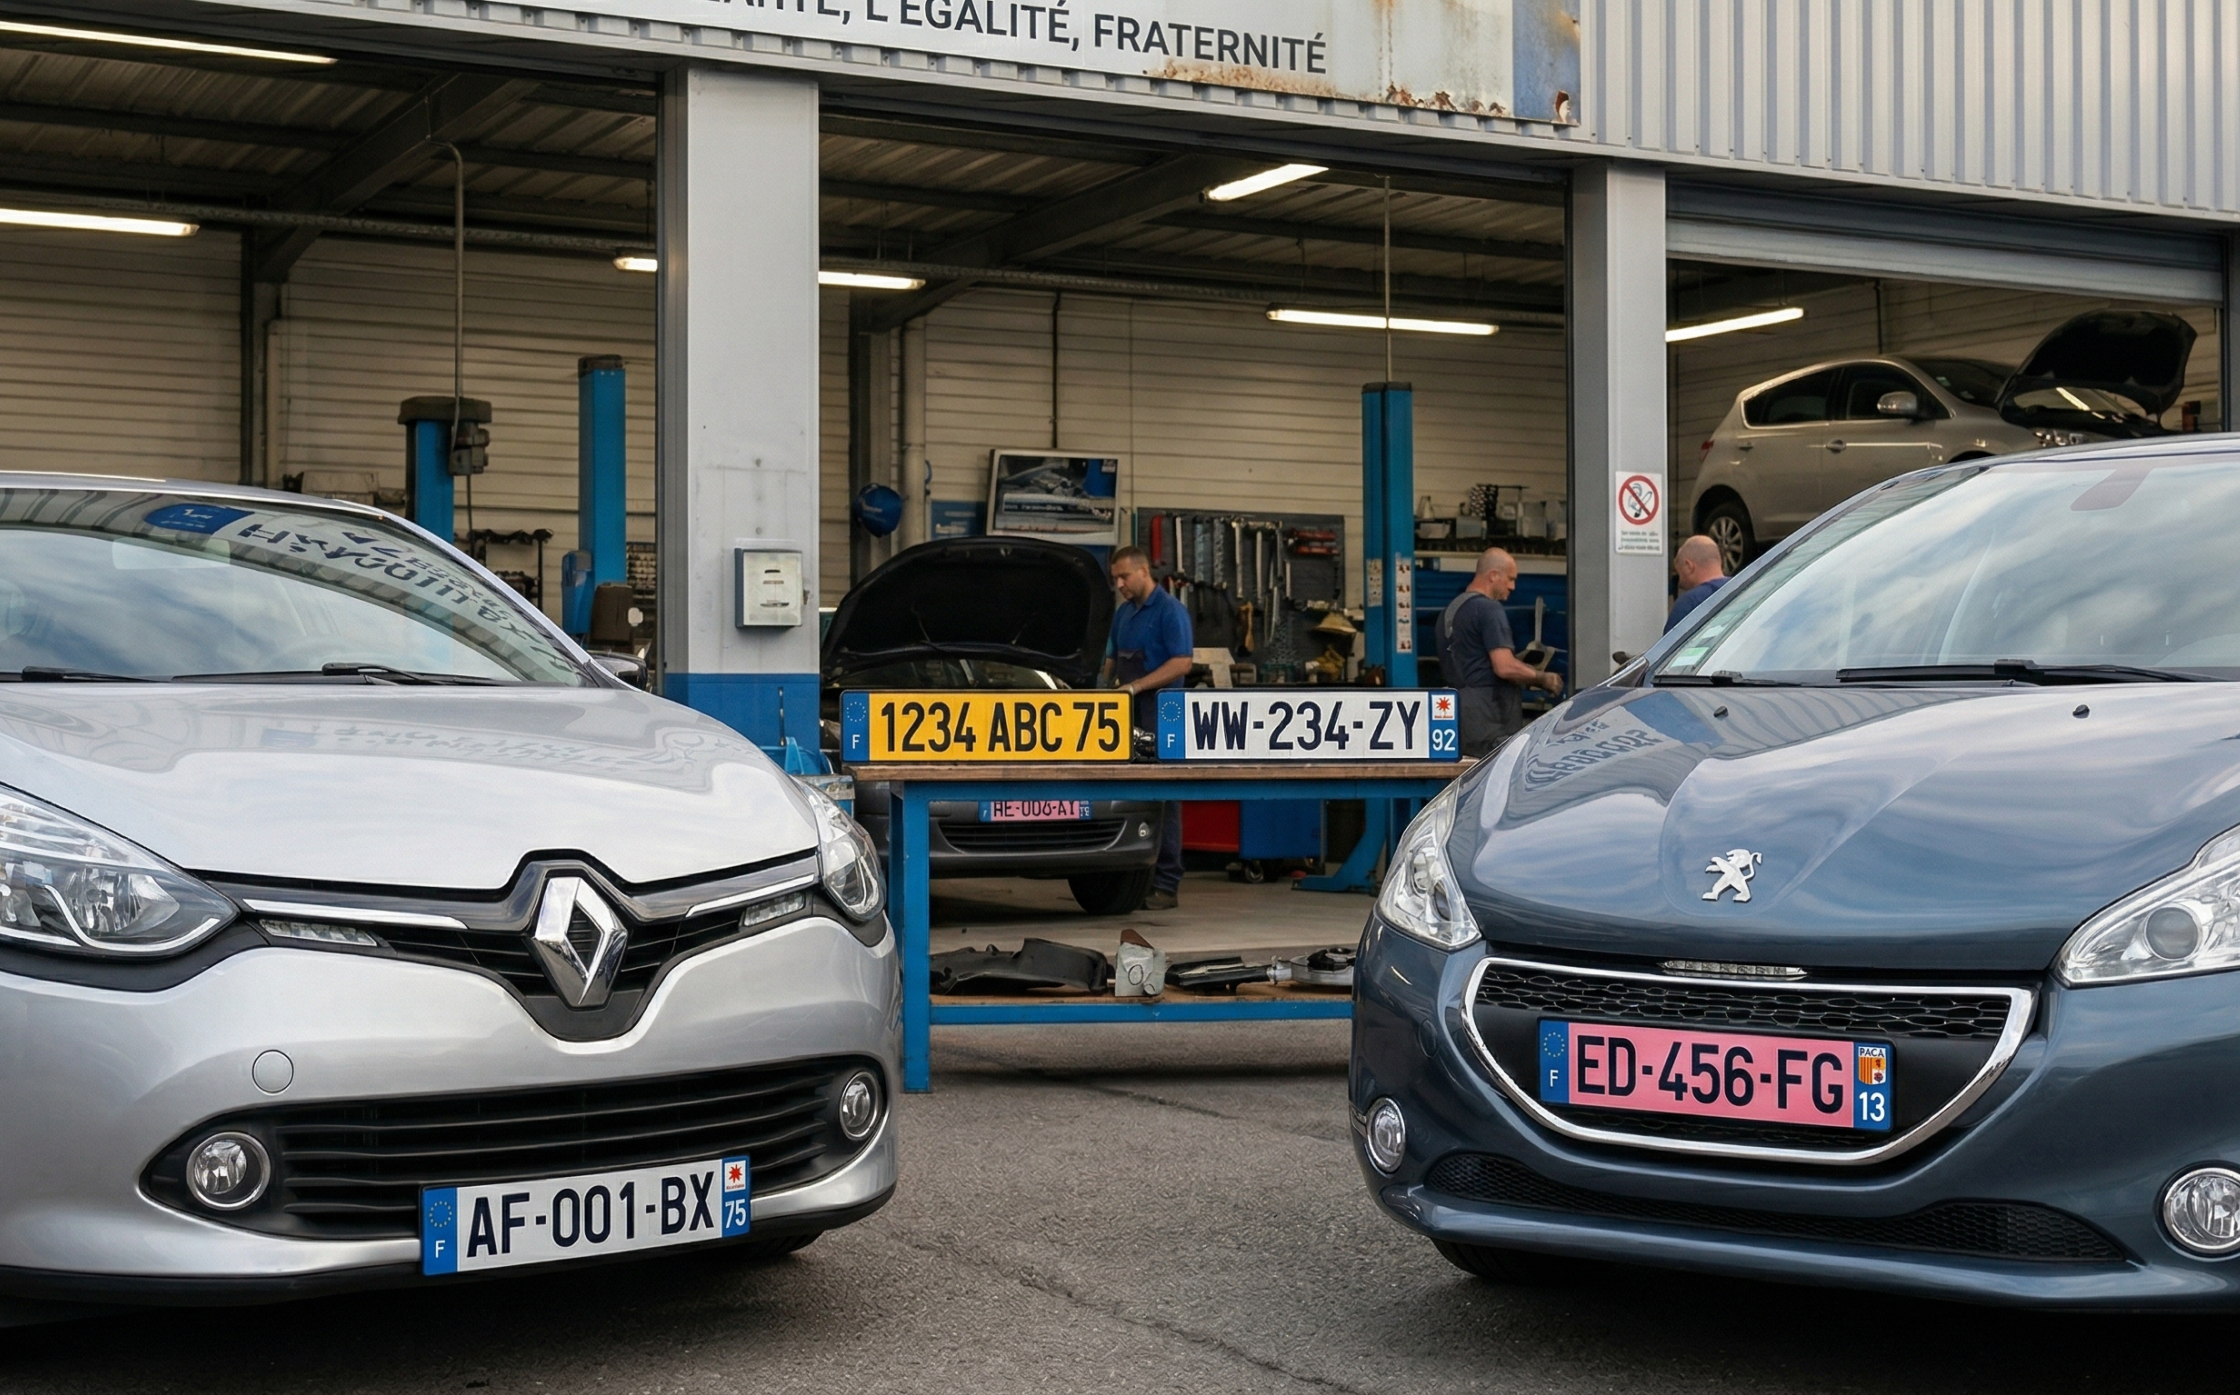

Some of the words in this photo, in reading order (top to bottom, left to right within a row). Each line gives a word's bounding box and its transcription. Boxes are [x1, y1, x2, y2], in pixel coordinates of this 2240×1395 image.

[1094, 13, 1327, 74] FRATERNITÉ
[881, 701, 976, 752] 1234
[988, 701, 1062, 752] ABC
[1072, 701, 1120, 752] 75
[1167, 733, 1175, 748] F
[1192, 701, 1421, 750] WW-234-ZY
[1432, 728, 1456, 751] 92
[852, 734, 860, 749] F
[1859, 1047, 1885, 1057] PACA
[1550, 1069, 1559, 1088] F
[1577, 1034, 1844, 1114] ED-456-FG
[1859, 1091, 1885, 1122] 13
[466, 1171, 715, 1258] AF-001-BX
[725, 1198, 746, 1229] 75
[435, 1239, 445, 1259] F
